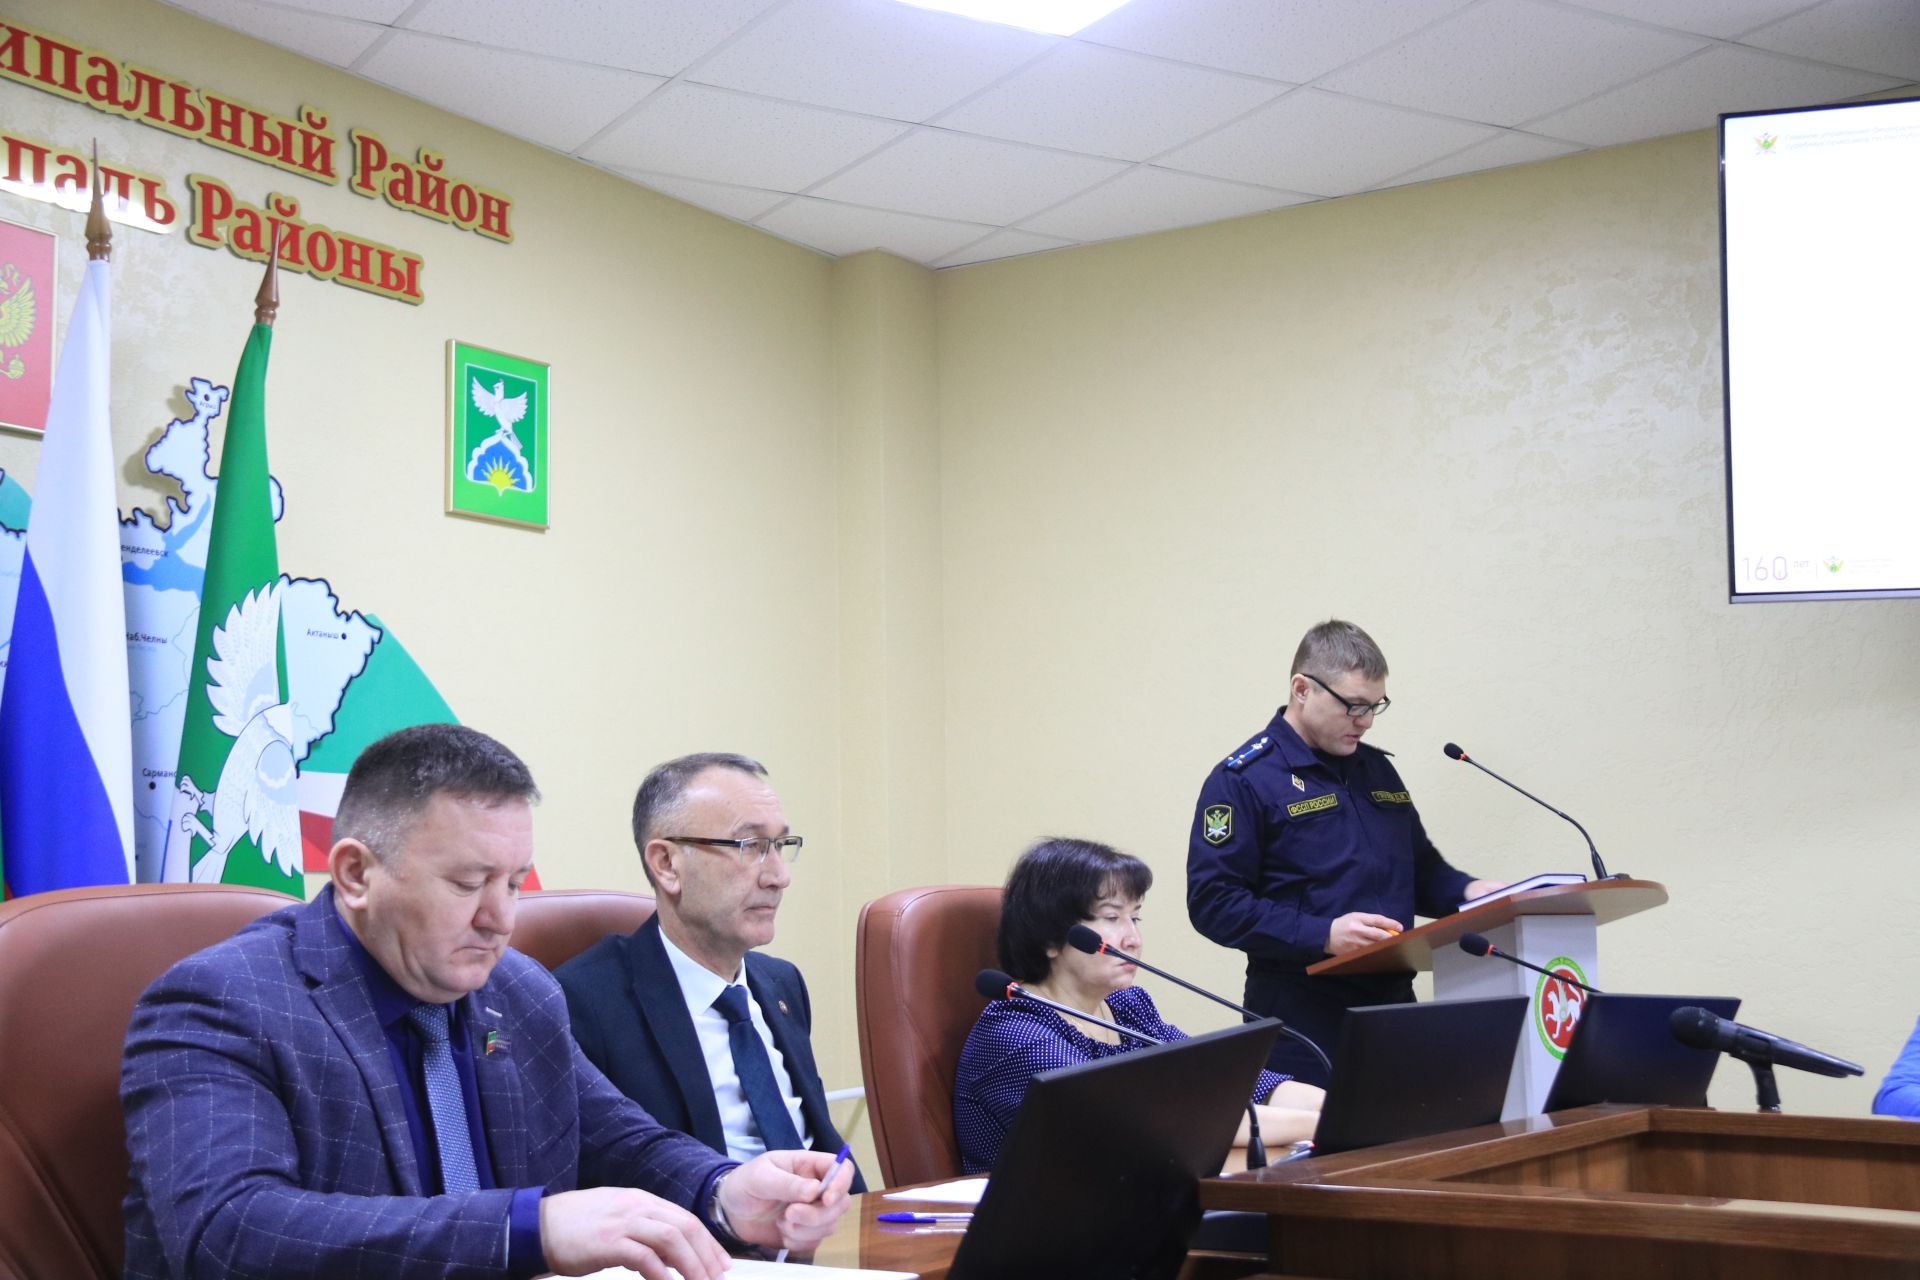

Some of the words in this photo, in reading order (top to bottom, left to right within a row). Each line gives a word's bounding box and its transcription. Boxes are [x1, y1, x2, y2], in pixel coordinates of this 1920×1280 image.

[0, 22, 336, 179] ипальный
[355, 134, 512, 238] Район
[1, 135, 176, 226] паль
[196, 180, 422, 298] Районы
[1742, 555, 1788, 581] 160
[1290, 802, 1310, 814] ФССП
[1309, 796, 1335, 809] РОССИИ
